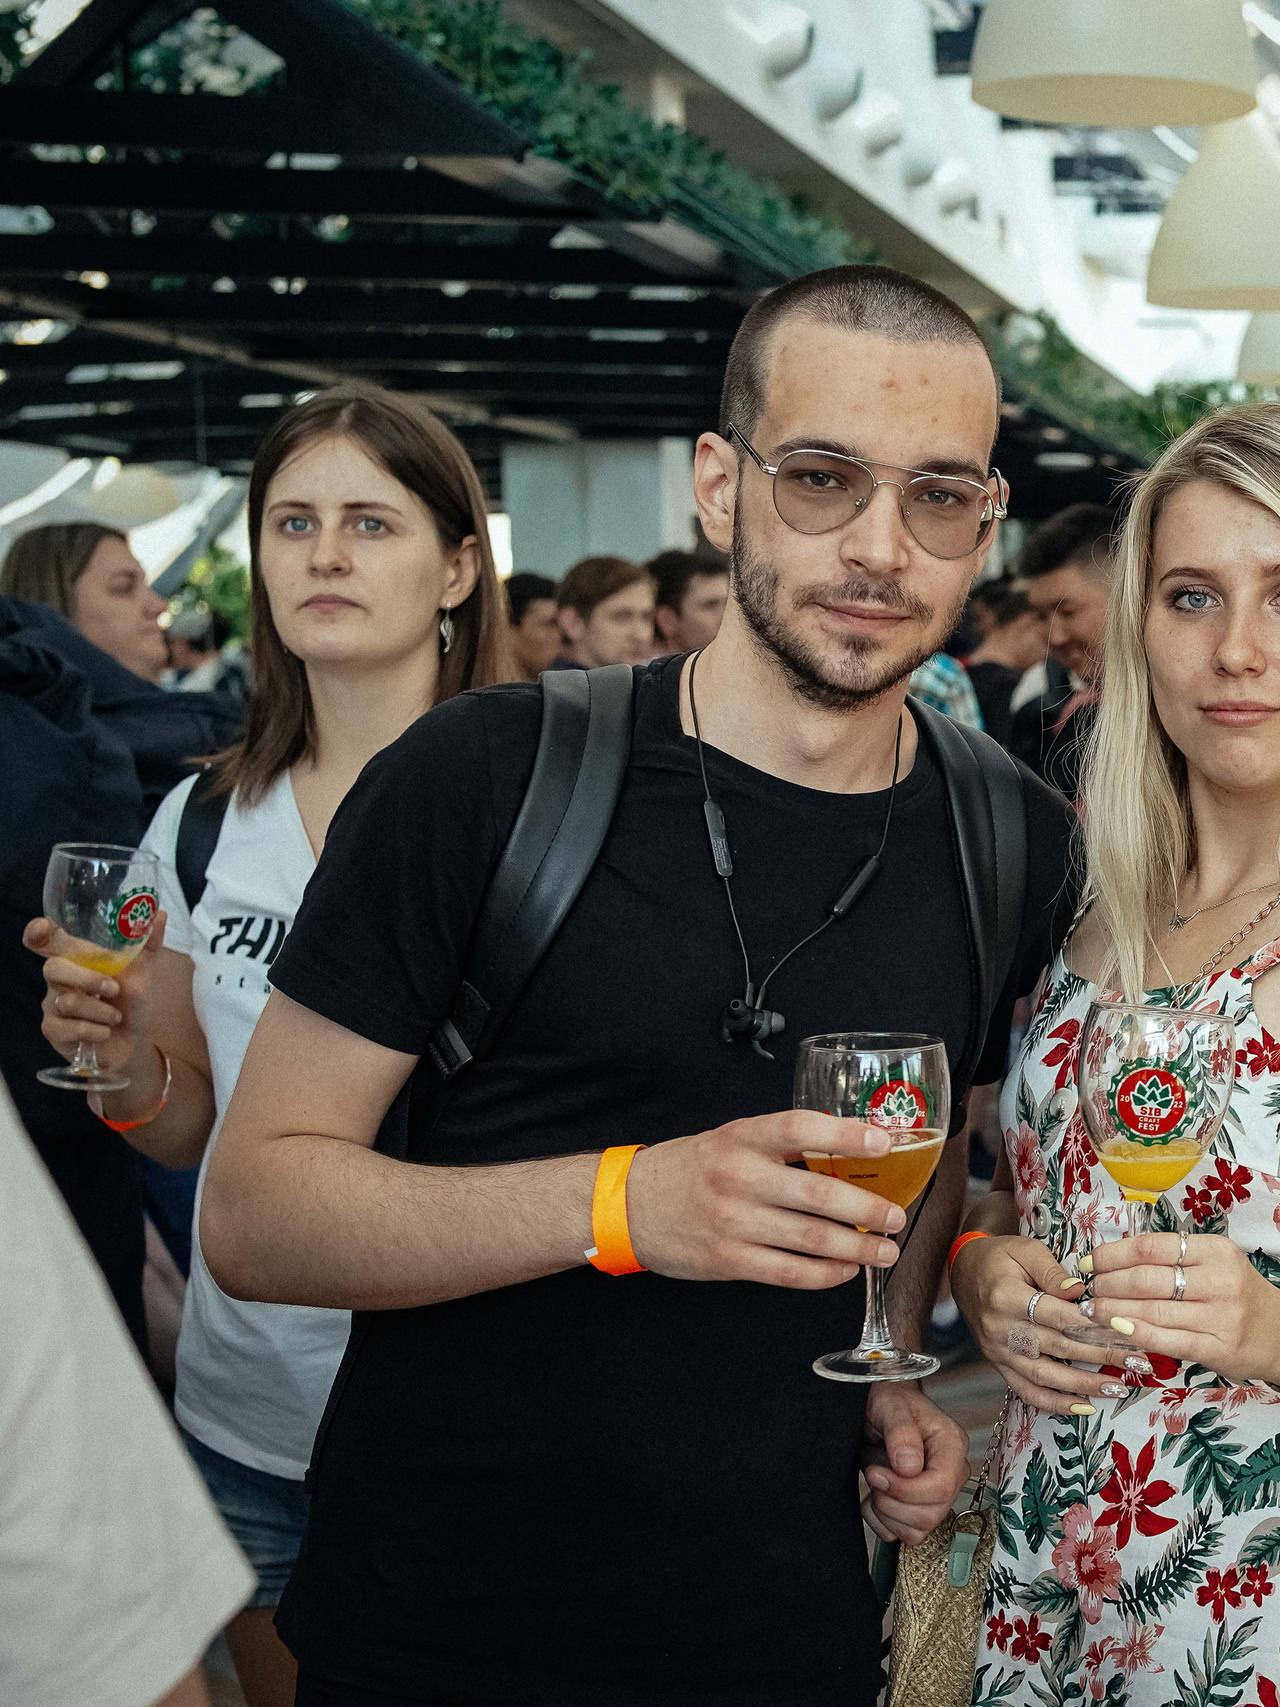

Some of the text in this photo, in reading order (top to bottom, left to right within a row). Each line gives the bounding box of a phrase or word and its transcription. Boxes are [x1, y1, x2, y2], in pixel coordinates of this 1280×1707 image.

[1120, 1094, 1184, 1109] 20 22
[1140, 1106, 1162, 1117] SIB
[1138, 1116, 1161, 1124] CRAFT
[1138, 1122, 1160, 1131] FEST
